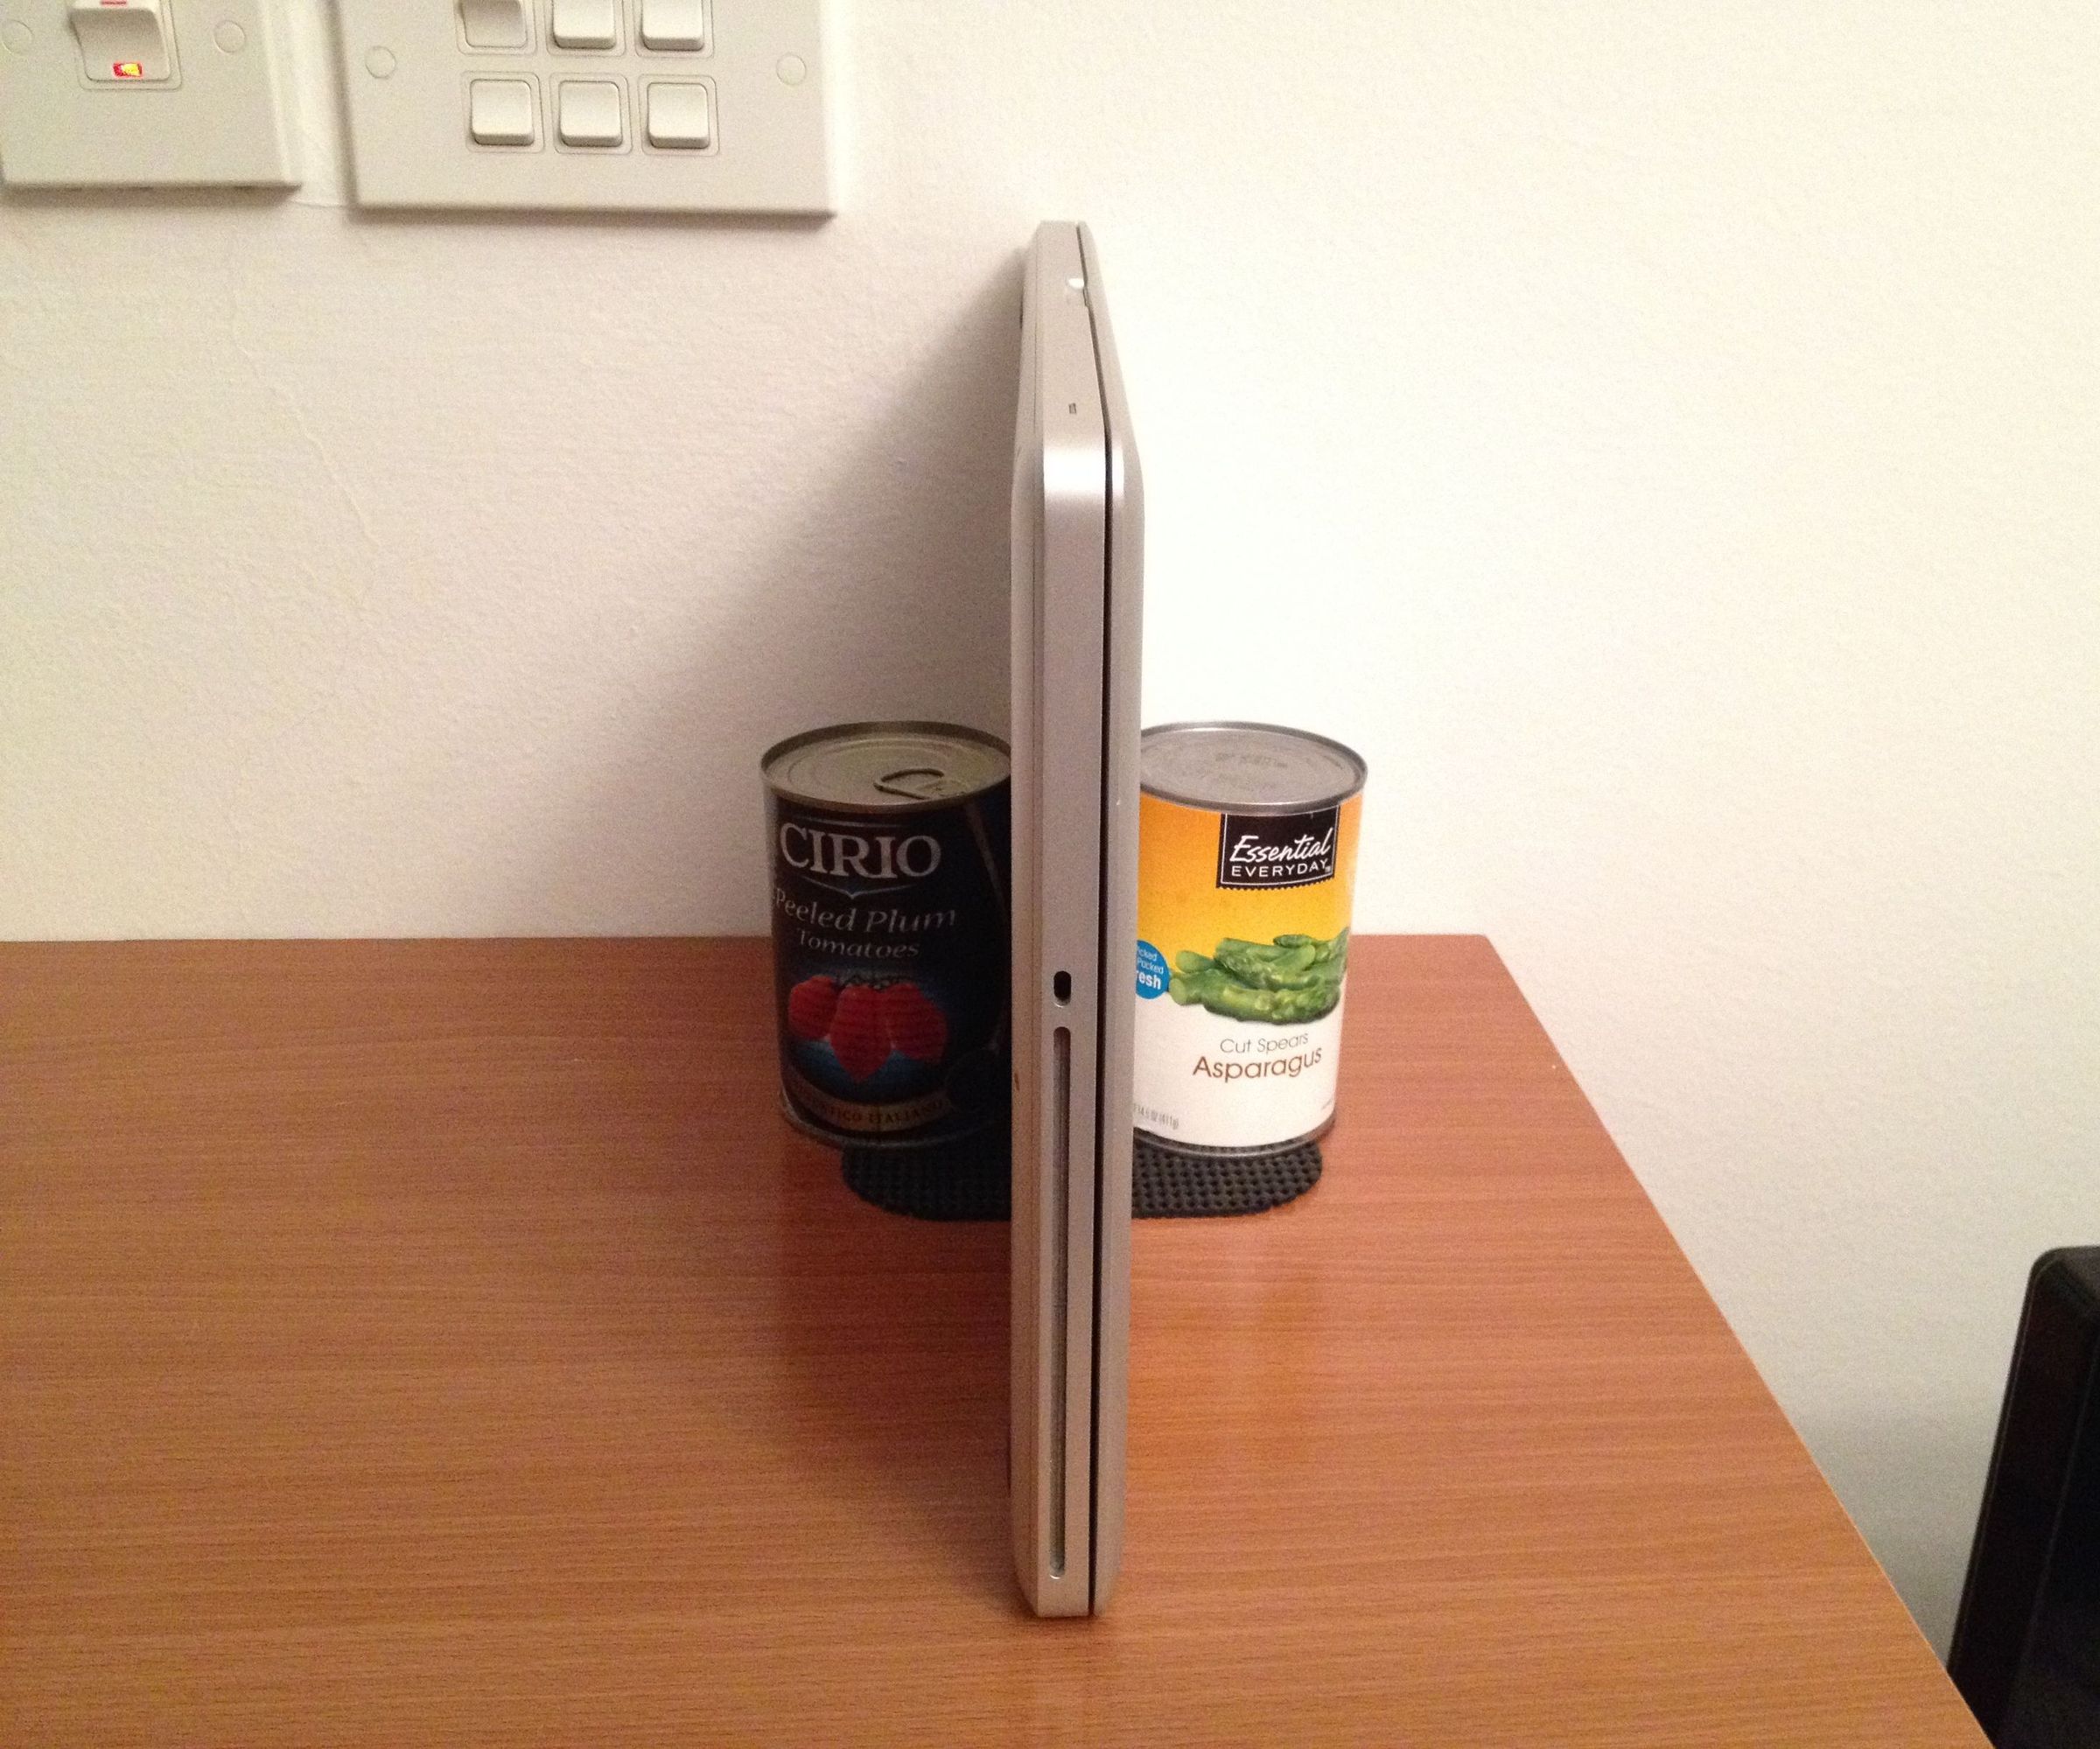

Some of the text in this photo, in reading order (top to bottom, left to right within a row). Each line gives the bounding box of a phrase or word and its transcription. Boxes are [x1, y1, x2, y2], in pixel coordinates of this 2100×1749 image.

[780, 822, 942, 879] CIRIO
[1229, 827, 1334, 863] Essential
[1231, 858, 1328, 878] EVERYDAY
[774, 887, 956, 934] Peeled Plum
[797, 927, 921, 959] Tomatoes
[1220, 1032, 1309, 1055] Cut Spears
[1193, 1046, 1323, 1083] Asparagus
